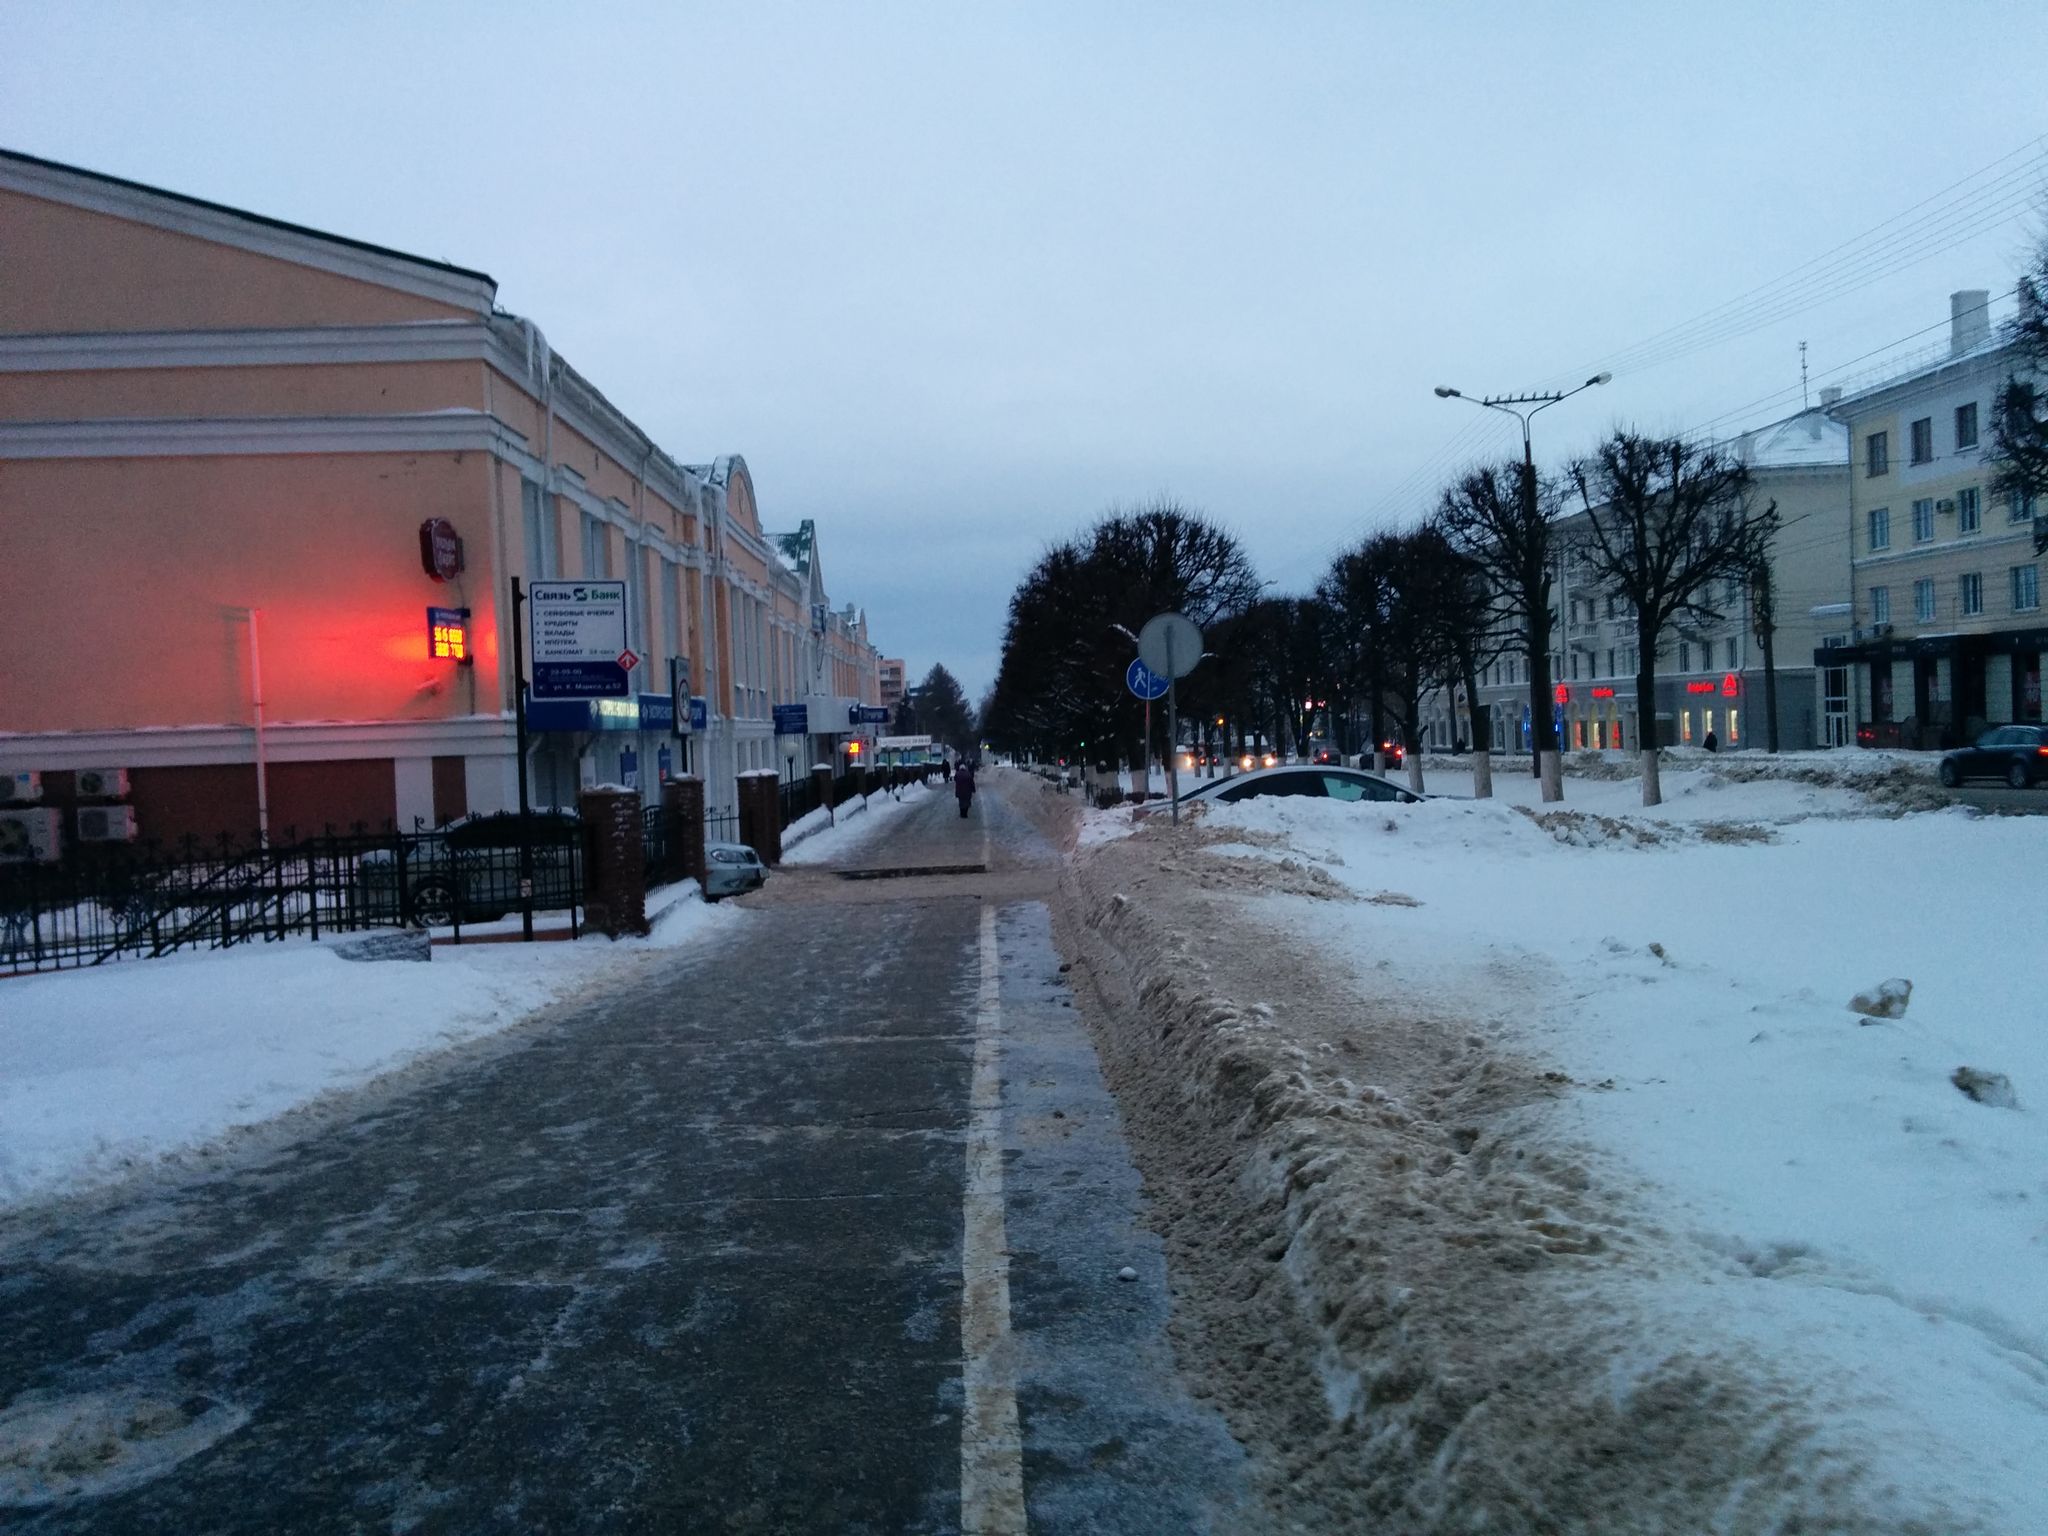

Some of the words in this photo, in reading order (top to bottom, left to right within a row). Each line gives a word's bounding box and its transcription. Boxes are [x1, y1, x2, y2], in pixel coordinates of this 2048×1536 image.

[535, 589, 571, 601] Связь
[591, 589, 620, 601] Банк
[544, 648, 583, 656] БАНКОМАТ
